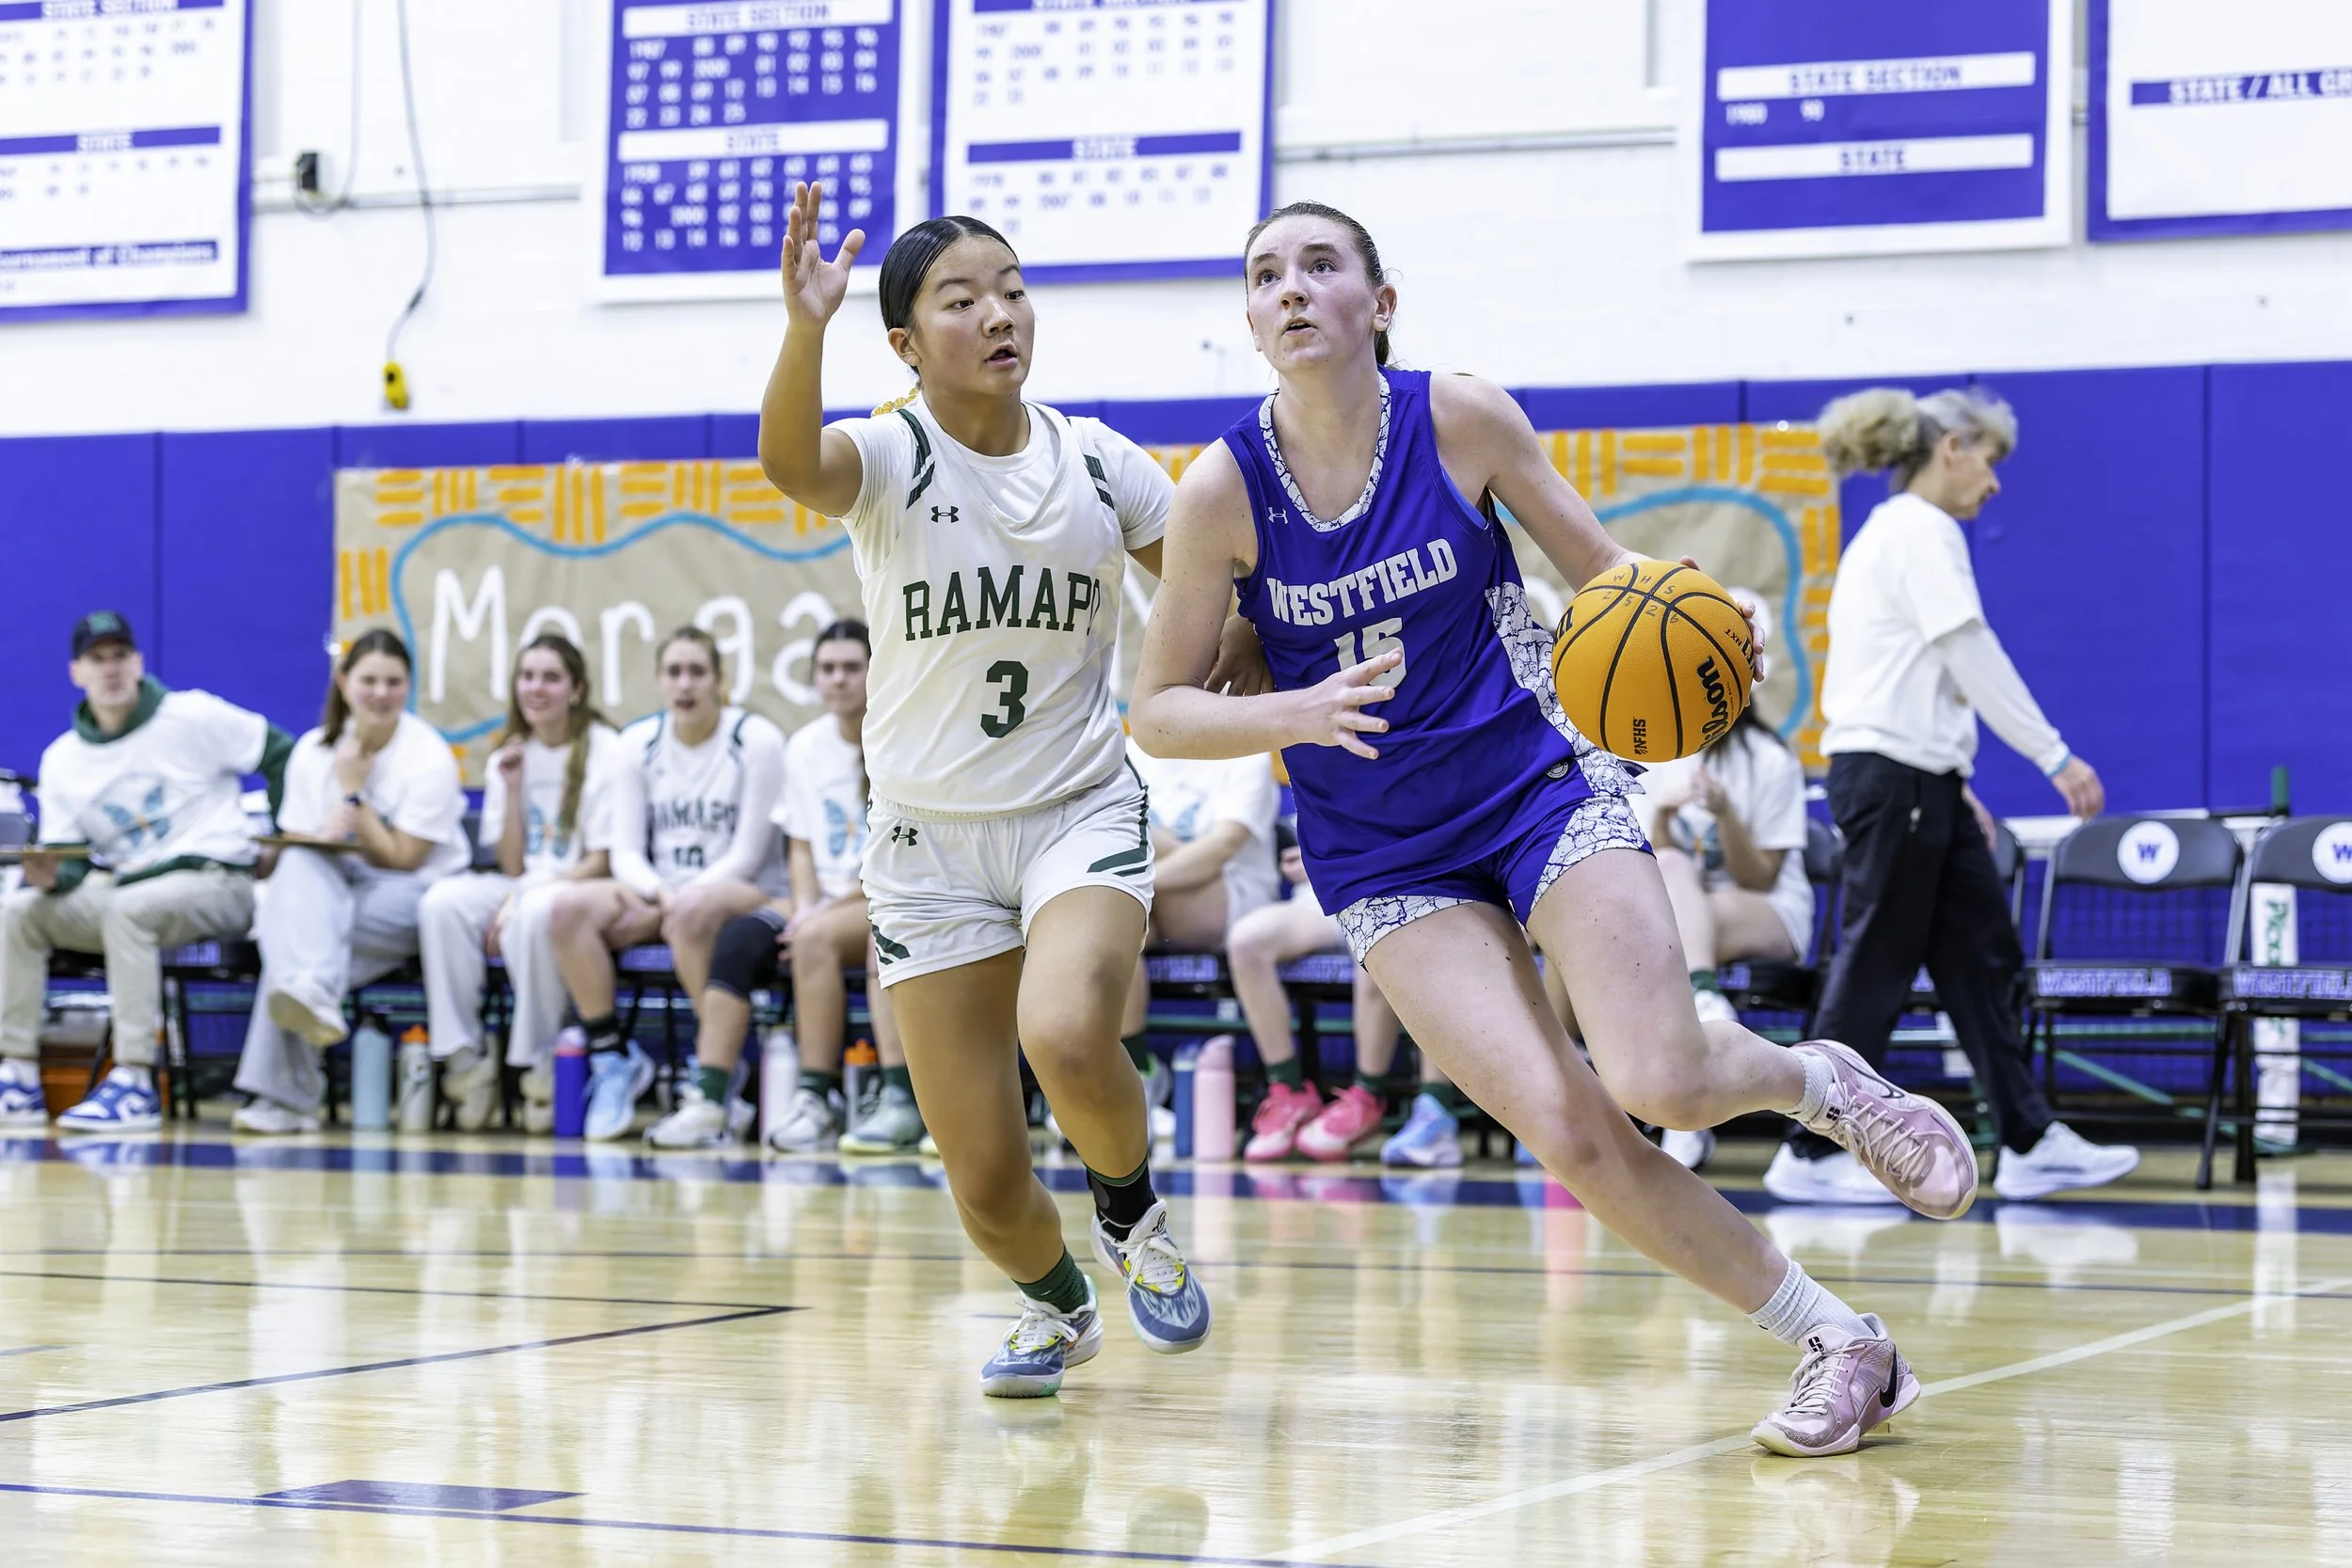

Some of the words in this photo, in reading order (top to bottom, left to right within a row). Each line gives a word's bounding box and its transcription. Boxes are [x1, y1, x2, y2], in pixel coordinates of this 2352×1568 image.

[1789, 67, 1852, 94] STATE
[1865, 62, 1962, 90] SECTION
[1840, 146, 1905, 173] STATE
[1266, 538, 1458, 626] WESTFIELD
[1333, 617, 1406, 689] 15
[980, 660, 1028, 738] 3
[1633, 718, 1646, 748] NFHS
[2138, 844, 2160, 863] W
[2333, 844, 2352, 863] W
